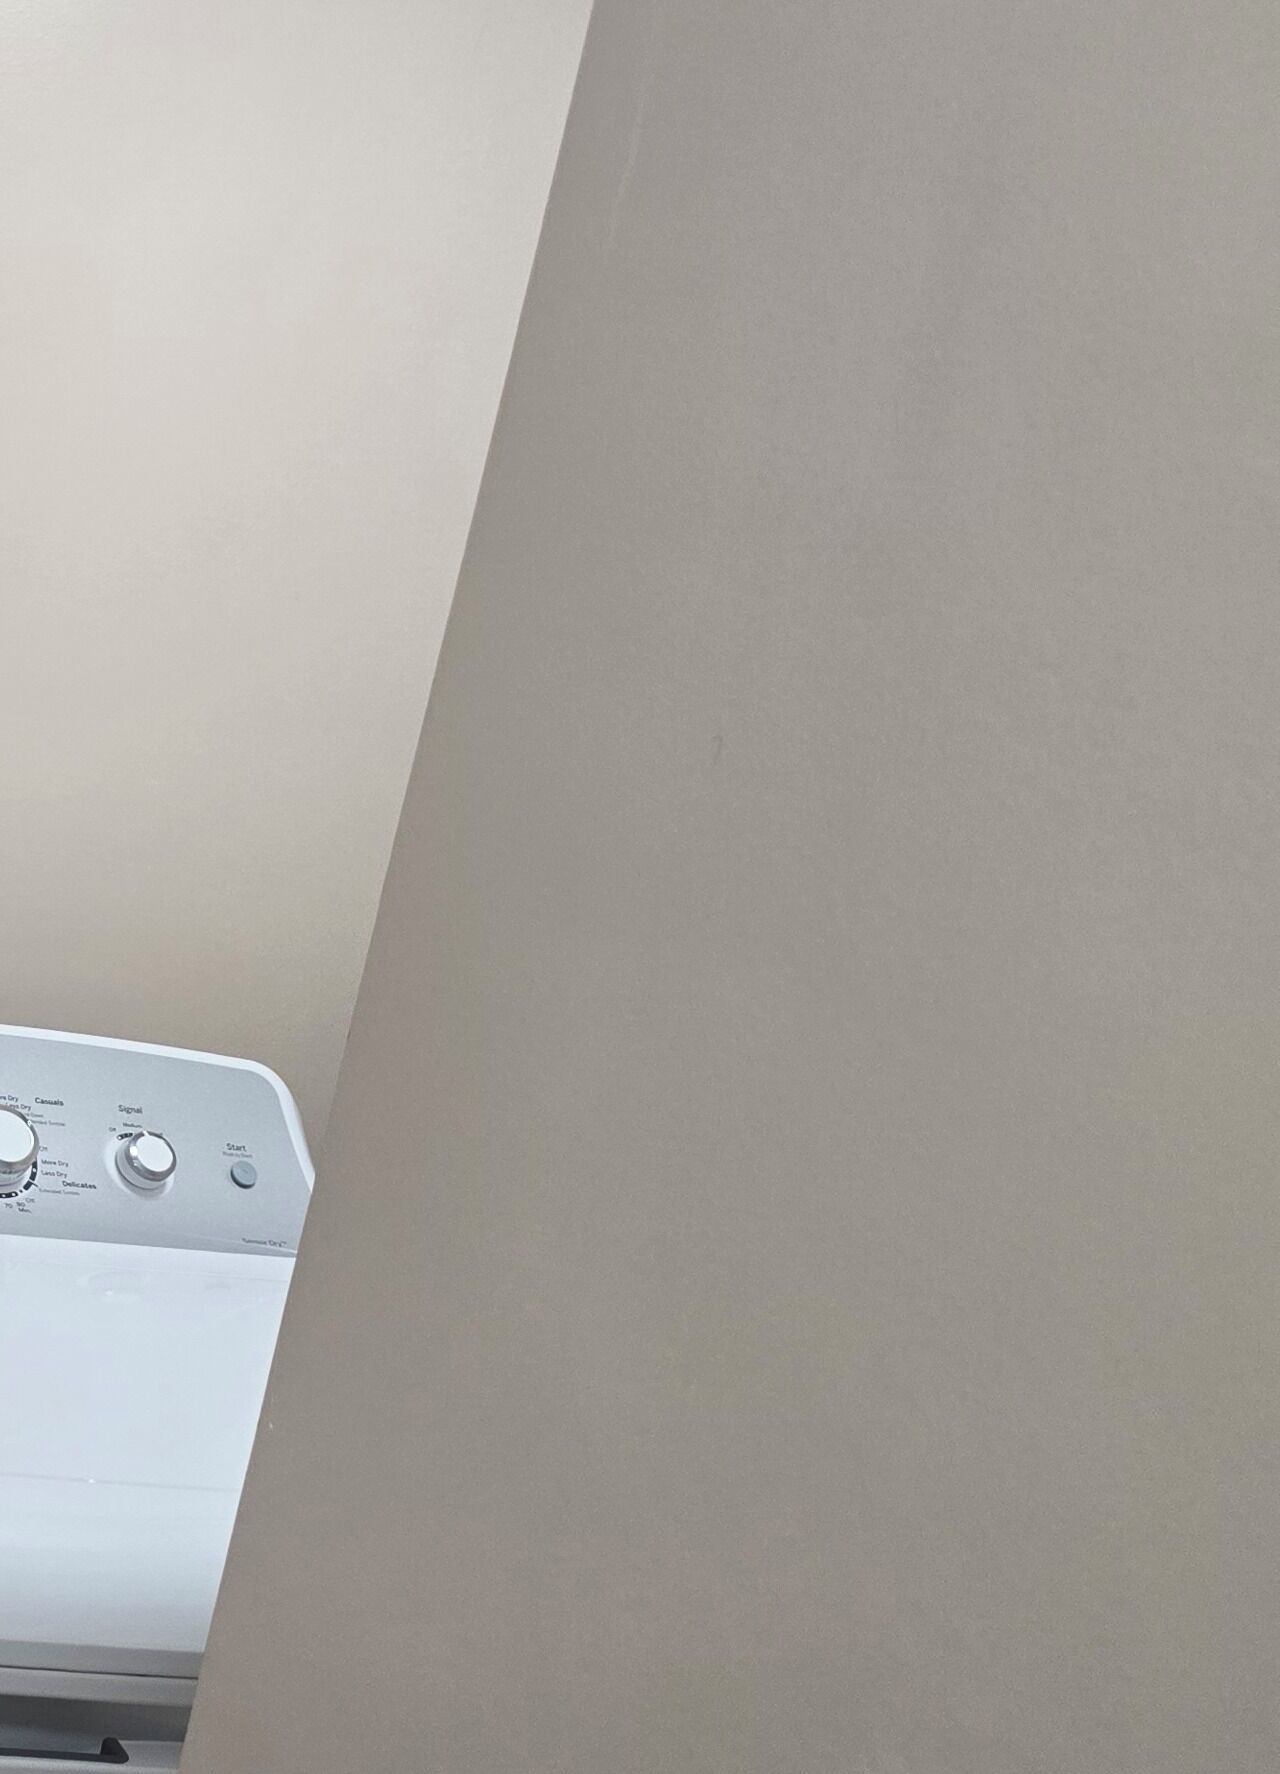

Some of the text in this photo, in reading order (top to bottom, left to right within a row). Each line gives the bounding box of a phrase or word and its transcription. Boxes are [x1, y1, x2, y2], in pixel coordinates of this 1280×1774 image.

[34, 1096, 65, 1107] Casuals
[118, 1104, 143, 1115] Signal
[226, 1142, 246, 1152] Start
[62, 1180, 98, 1190] Delicates
